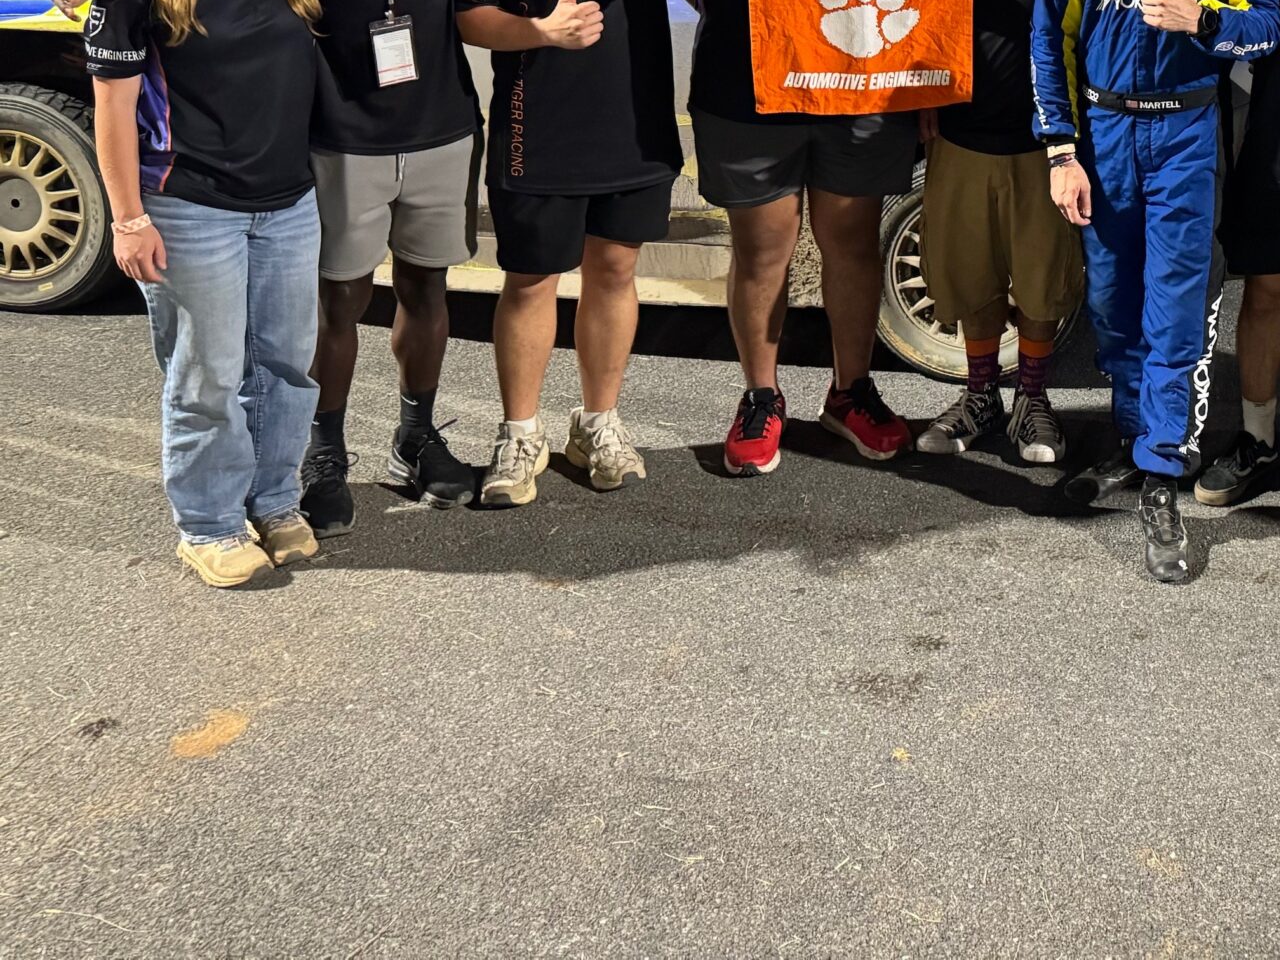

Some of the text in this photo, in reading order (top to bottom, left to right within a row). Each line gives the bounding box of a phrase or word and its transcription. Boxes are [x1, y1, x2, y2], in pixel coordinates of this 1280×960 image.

[783, 69, 950, 91] AUTOMOTIVE ENGINEERING
[1139, 100, 1181, 110] MARTELL
[511, 79, 524, 177] TIGER RACING
